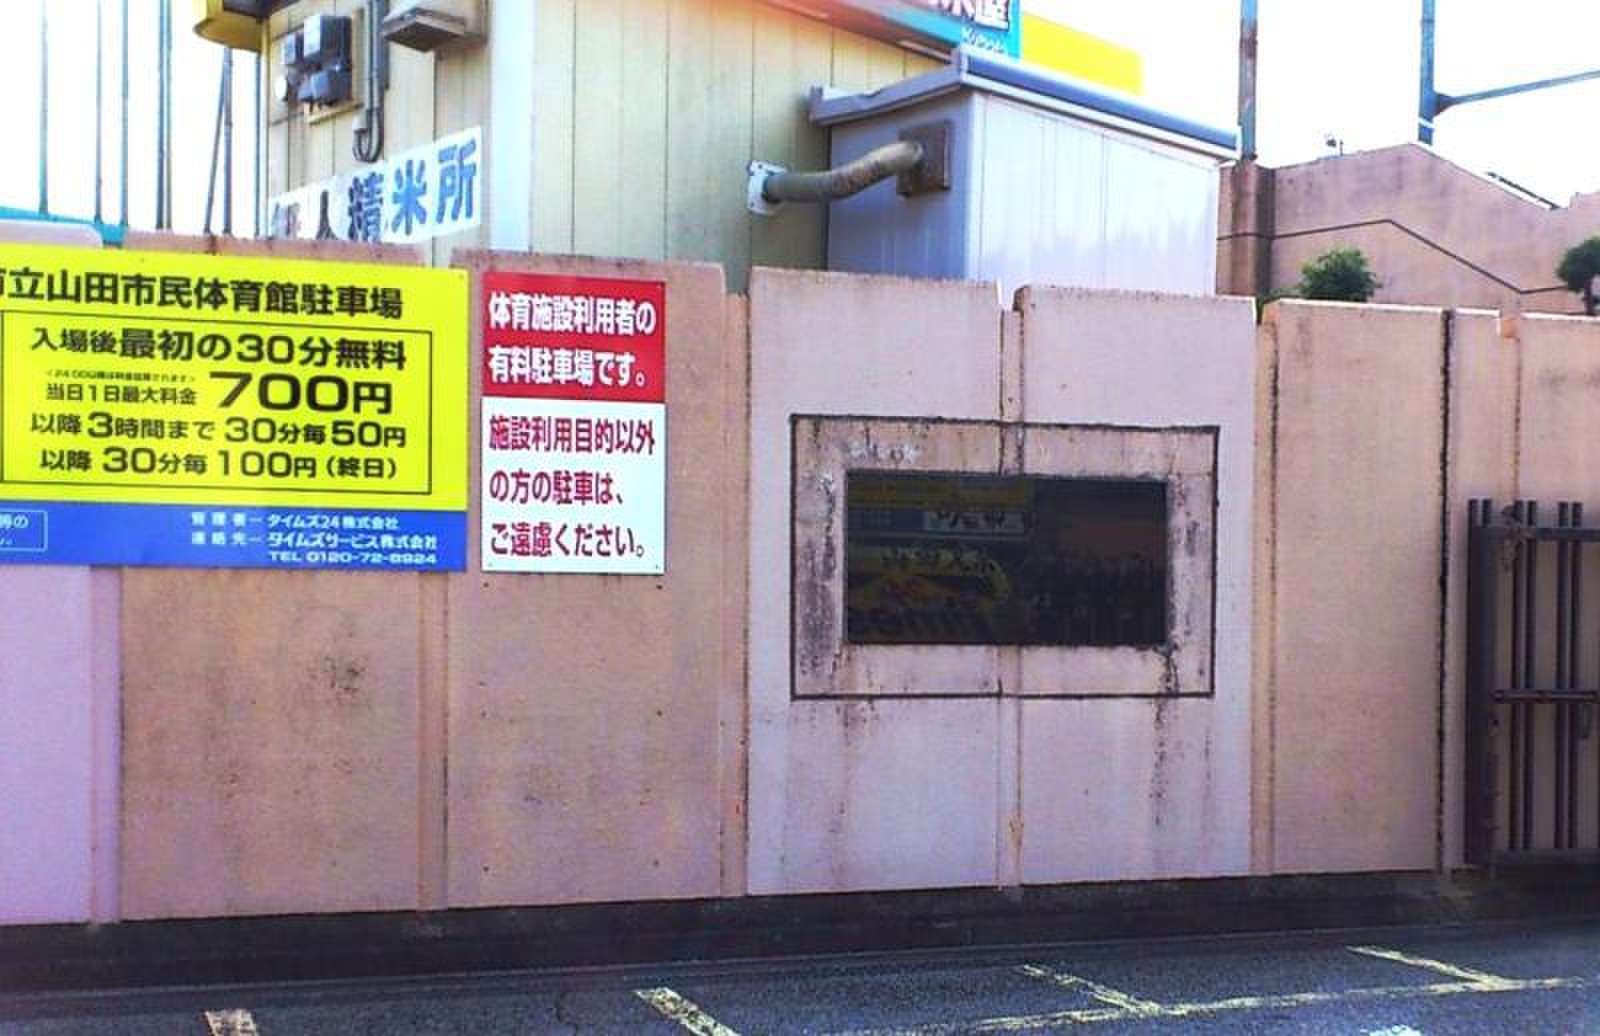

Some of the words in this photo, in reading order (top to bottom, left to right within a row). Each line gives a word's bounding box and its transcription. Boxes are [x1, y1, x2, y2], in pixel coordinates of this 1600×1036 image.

[0, 267, 403, 319] 立山田市民体育館駐車場
[488, 292, 656, 336] 体育施設利用者の
[31, 327, 406, 371] 入場後最初の30分無料
[488, 345, 645, 387] 有料駐車場です。
[46, 383, 197, 405] 当日1日最大料金
[209, 371, 392, 414] 700円
[489, 415, 655, 455] 施設利用目的以外
[489, 468, 623, 505] の方の駐車は、
[269, 551, 301, 562] TEL
[490, 521, 644, 558] ご遠慮ください。
